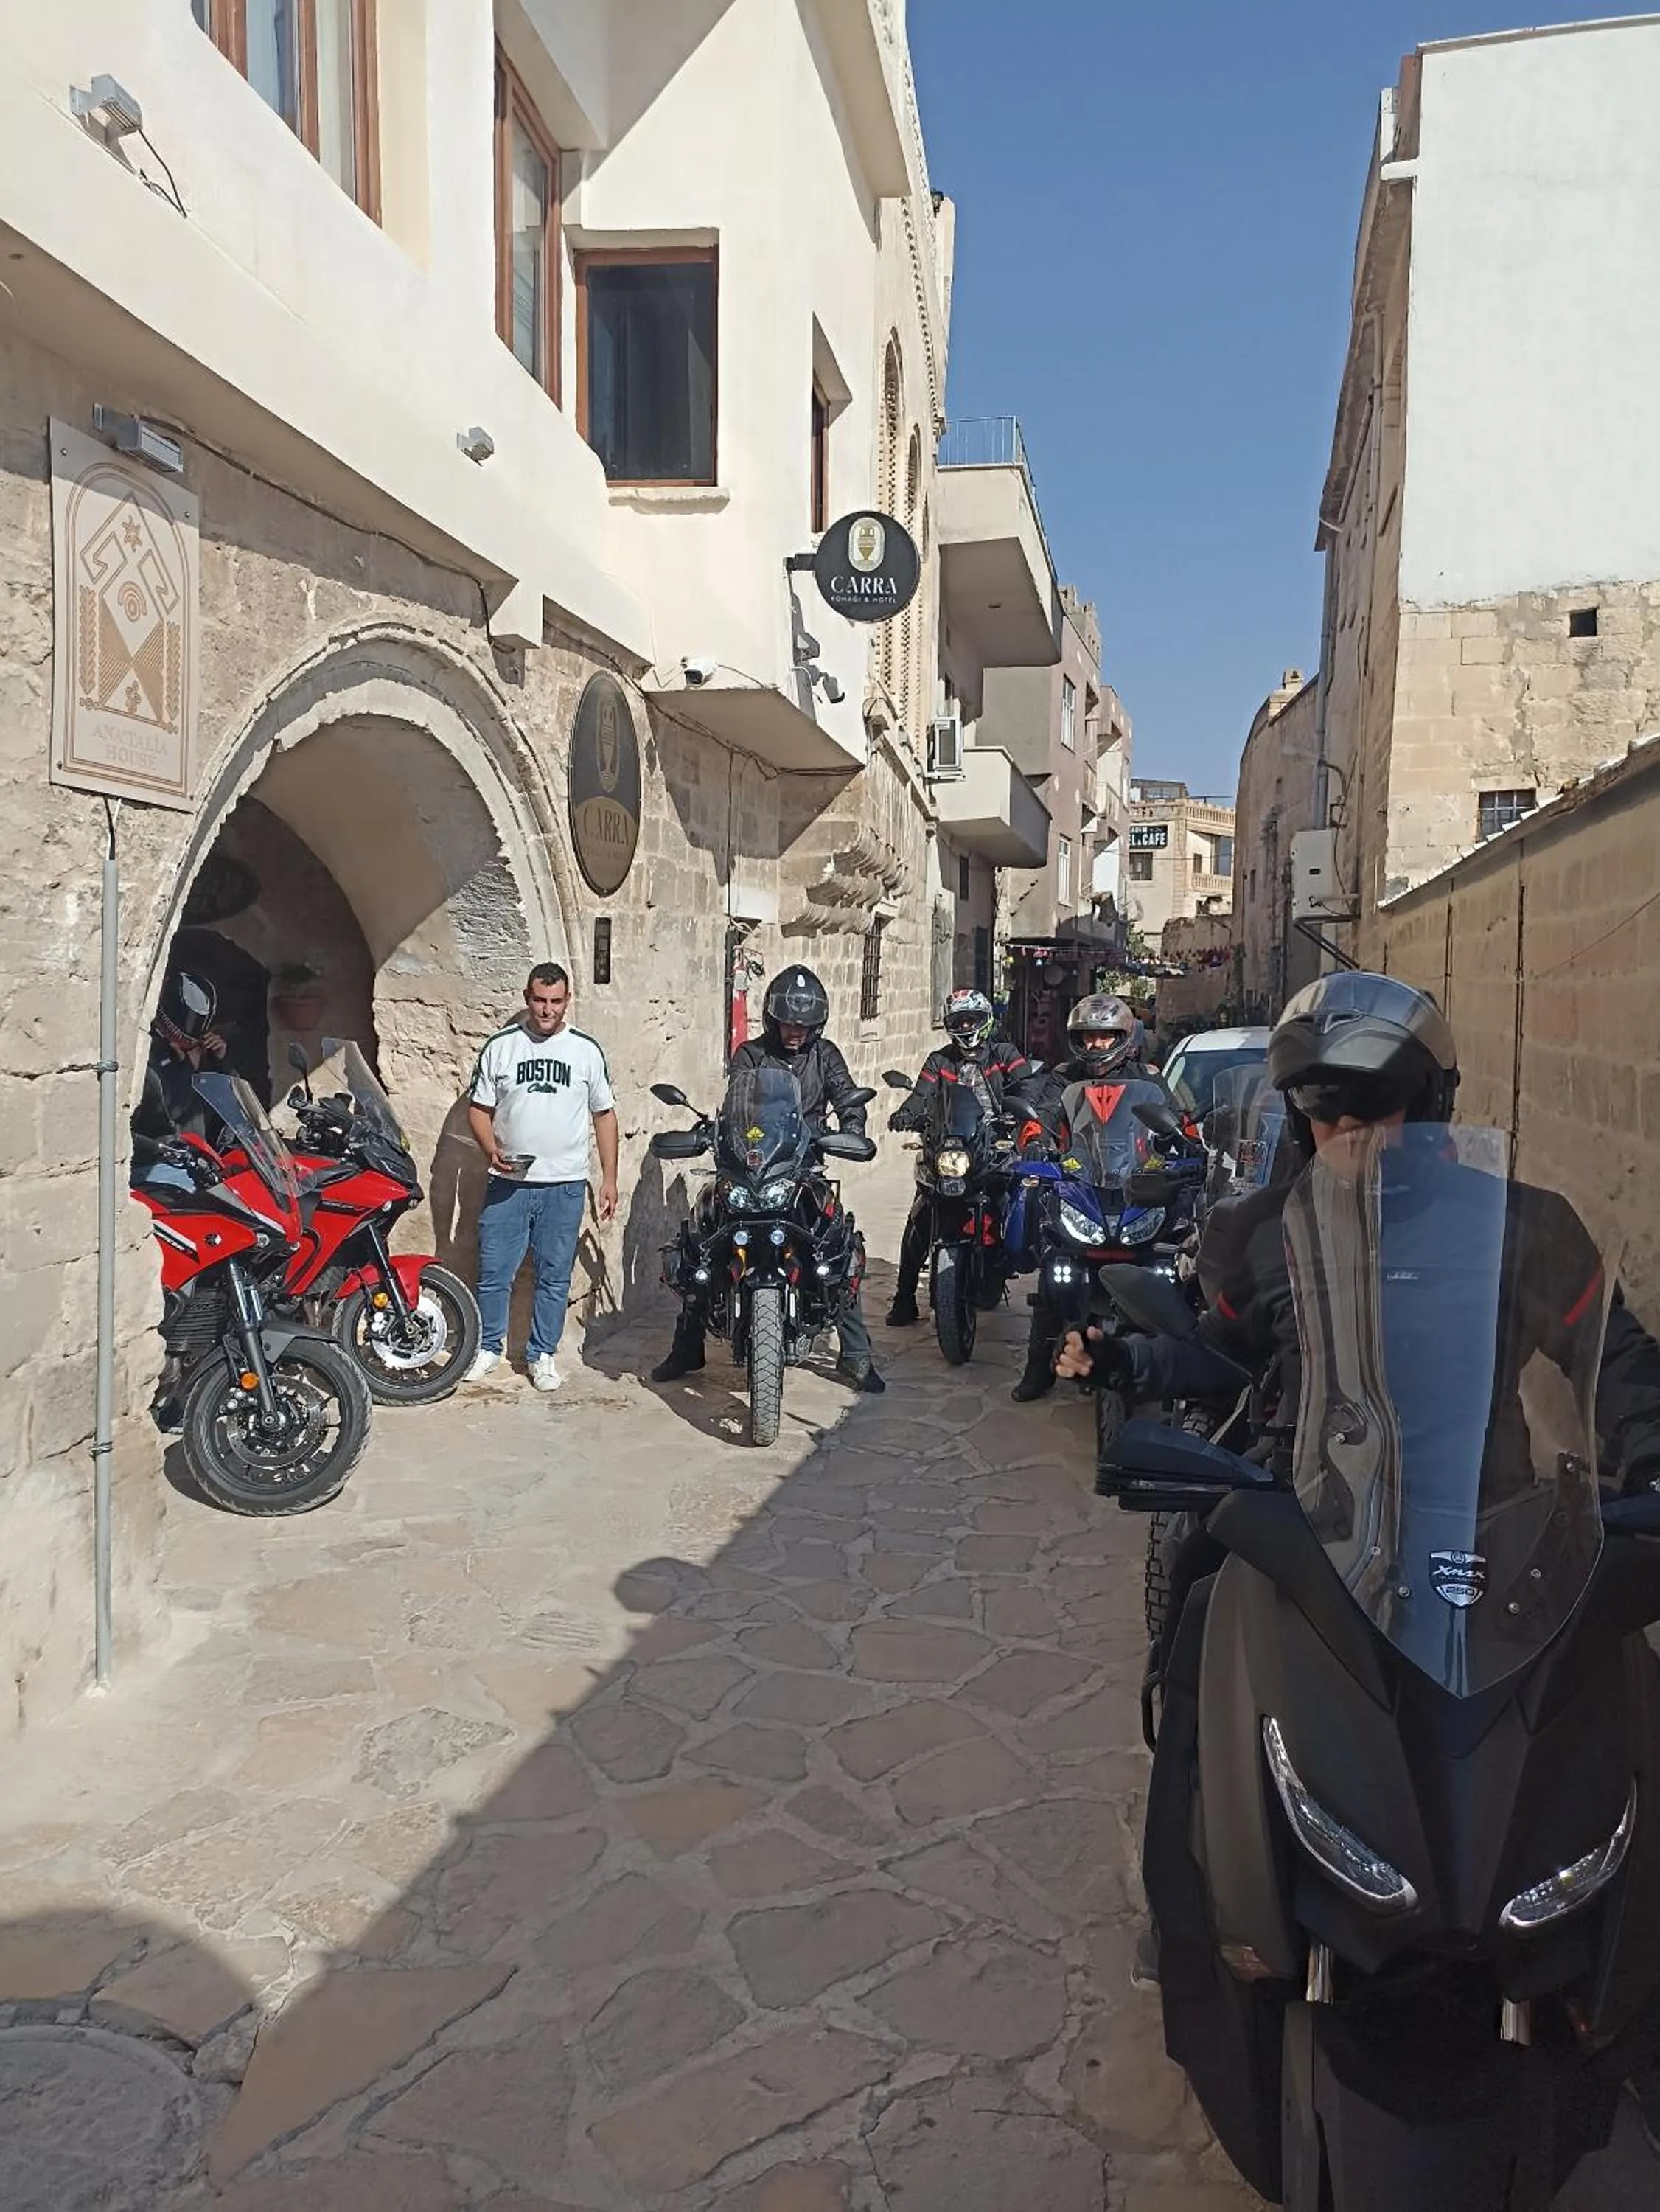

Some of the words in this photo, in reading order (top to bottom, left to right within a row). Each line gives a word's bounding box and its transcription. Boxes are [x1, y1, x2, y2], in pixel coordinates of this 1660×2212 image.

[831, 575, 897, 594] CARRA
[105, 744, 158, 771] HOUSE
[582, 804, 630, 846] CARRA
[1142, 832, 1165, 846] CAFE
[516, 1058, 571, 1088] BOSTON
[1445, 1586, 1475, 1596] 250
